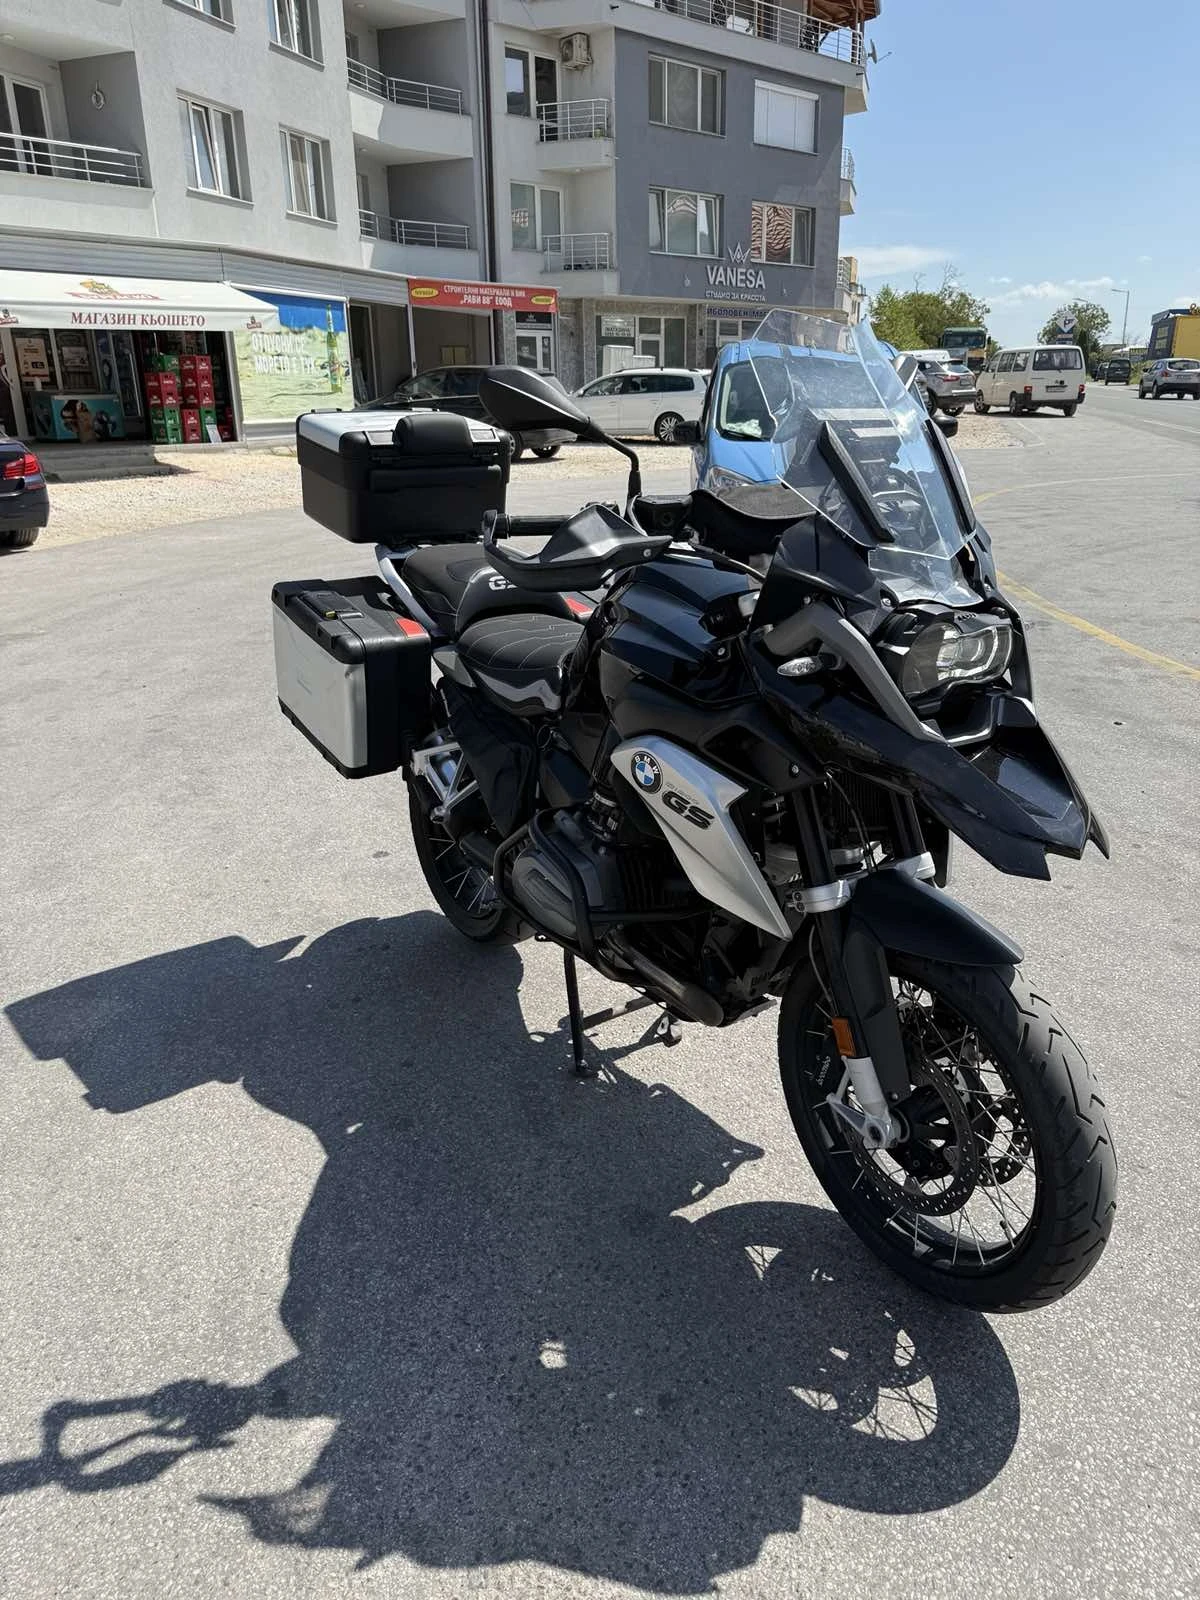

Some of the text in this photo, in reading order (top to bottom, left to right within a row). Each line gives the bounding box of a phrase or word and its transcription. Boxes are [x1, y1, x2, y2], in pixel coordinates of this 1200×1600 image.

[706, 265, 766, 289] VANESA
[71, 312, 206, 327] МАГАЗИН КЬОШЕТО
[705, 308, 750, 318] ИБОЛОВЕН
[634, 755, 660, 775] BMW
[662, 790, 715, 830] GS
